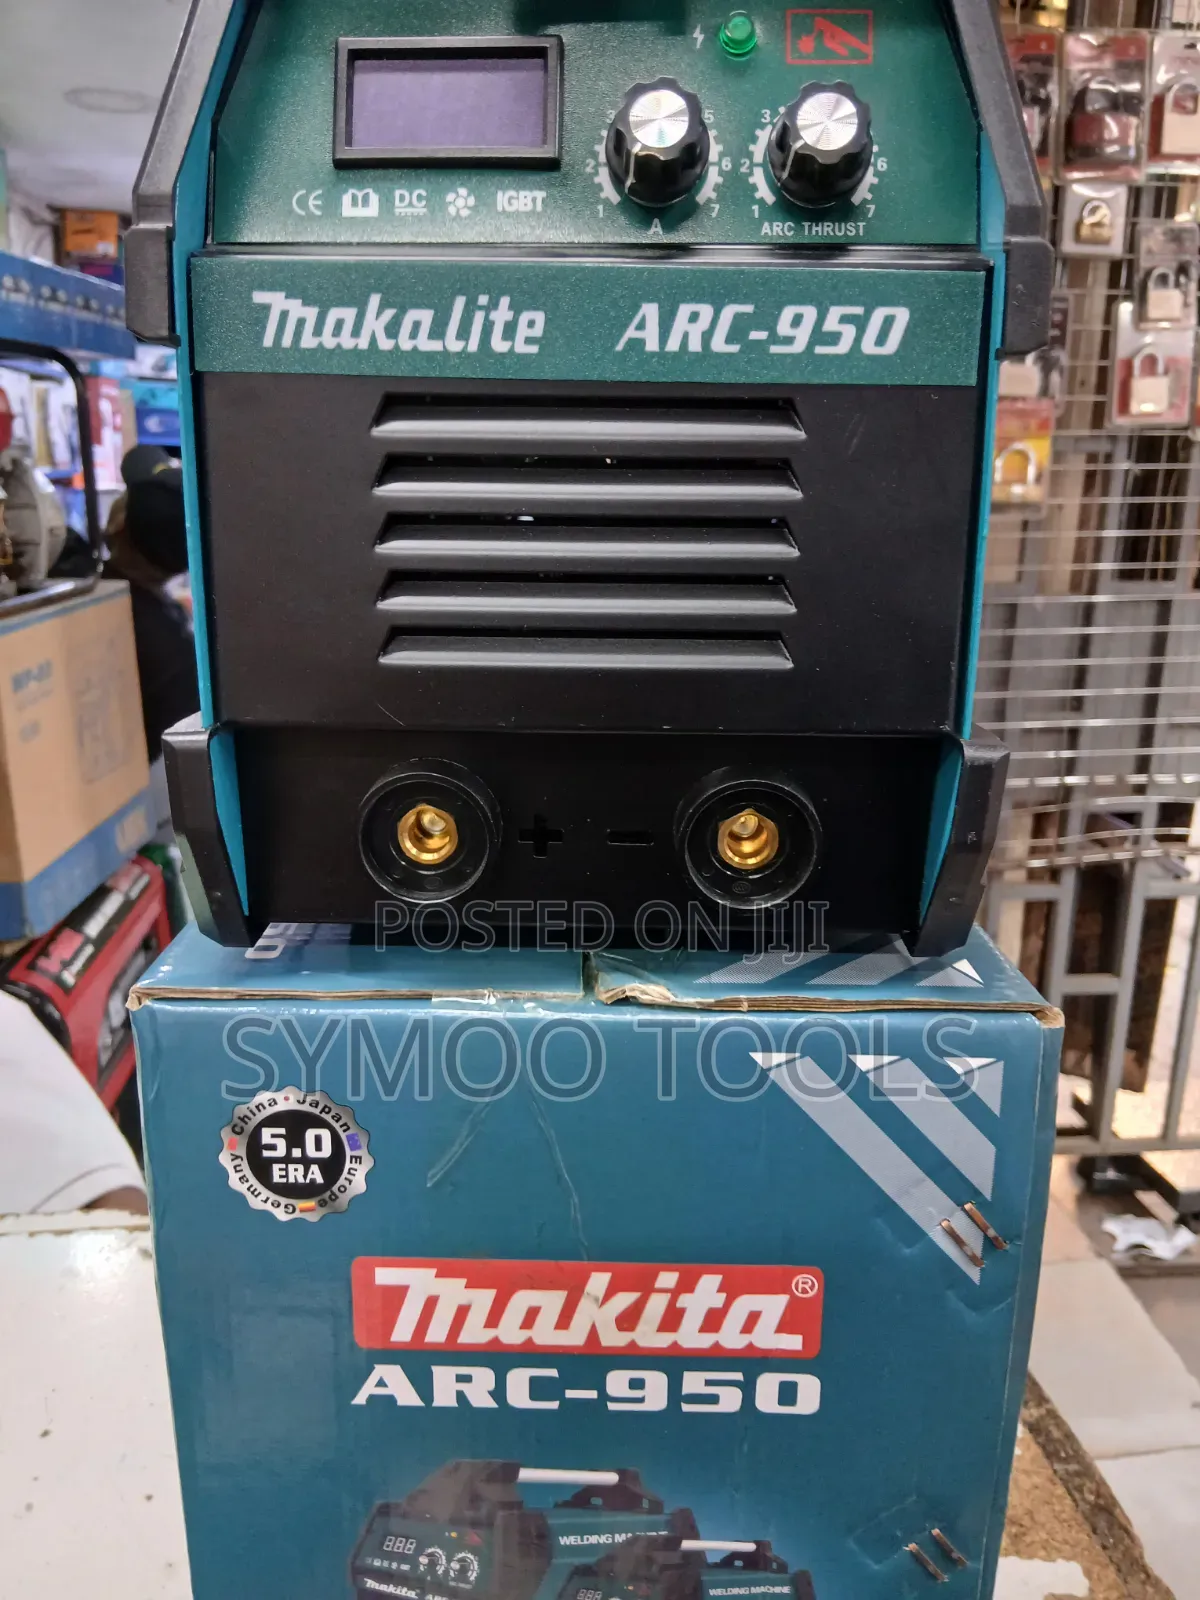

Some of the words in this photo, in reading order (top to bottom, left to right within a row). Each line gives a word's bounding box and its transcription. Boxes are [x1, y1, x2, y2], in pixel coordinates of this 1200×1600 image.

[703, 109, 715, 123] 5
[761, 109, 771, 123] 3
[585, 158, 596, 173] 2
[721, 157, 732, 171] 6
[739, 158, 750, 173] 2
[877, 158, 888, 171] 6
[394, 188, 427, 208] DC
[496, 190, 547, 212] IGBT
[597, 204, 604, 218] 1
[710, 204, 720, 218] 7
[751, 204, 760, 219] 1
[866, 204, 876, 218] 7
[648, 218, 664, 235] A
[761, 221, 795, 236] ARC
[802, 221, 867, 236] THRUST
[252, 291, 546, 354] Makalite
[615, 302, 910, 355] ARC-950
[231, 1097, 279, 1136] China
[296, 1094, 351, 1133] Japan
[260, 1127, 332, 1159] 5.0
[272, 1163, 324, 1184] ERA
[317, 1154, 362, 1208] Europe
[229, 1152, 297, 1215] Germany
[374, 1266, 804, 1351] Makita
[351, 1363, 821, 1415] ARC-950
[558, 1534, 613, 1545] WELDING
[708, 1586, 750, 1596] WELDING
[750, 1585, 792, 1594] MACHINE
